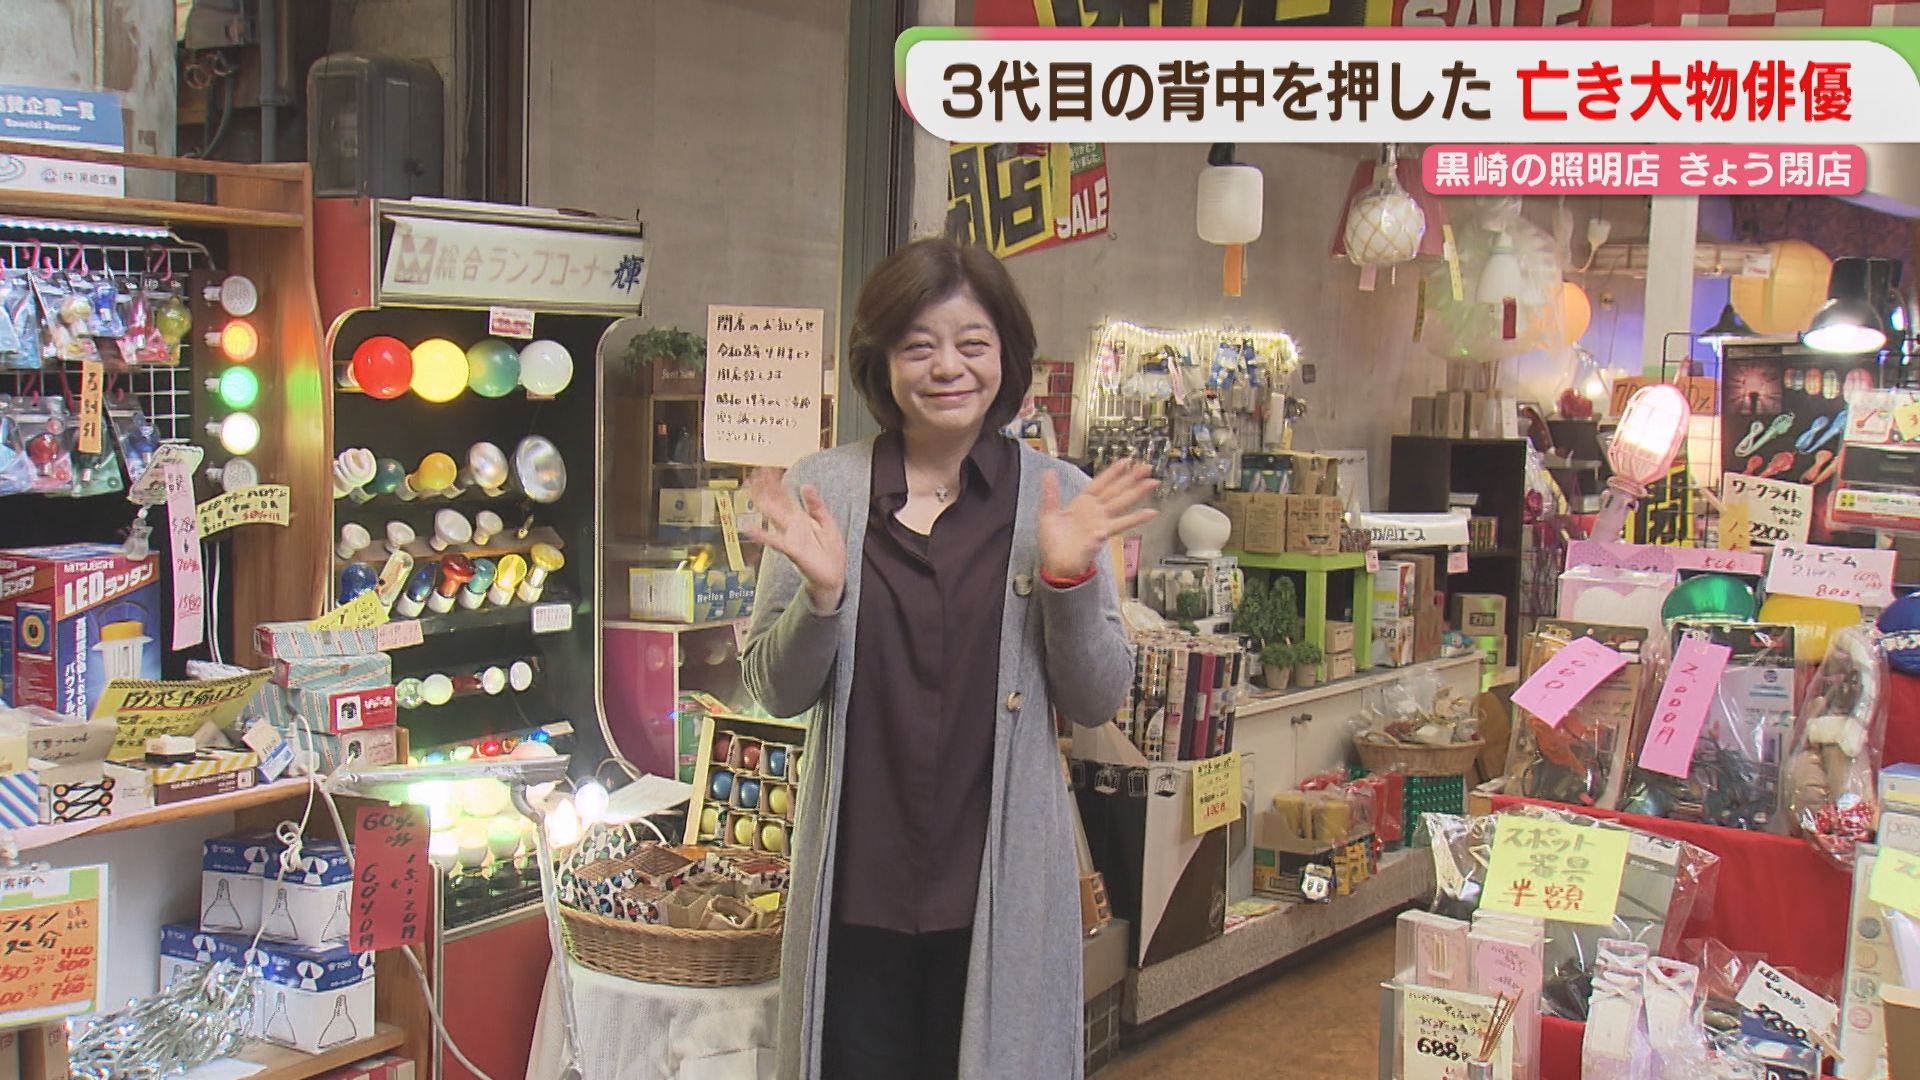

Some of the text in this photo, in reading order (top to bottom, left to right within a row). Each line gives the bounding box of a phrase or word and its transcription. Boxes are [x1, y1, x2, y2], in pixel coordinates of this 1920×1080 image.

[64, 562, 153, 615] LEDランタン
[1502, 826, 1596, 853] スポット
[0, 875, 45, 891] 客様へ
[1504, 878, 1585, 912] 半額
